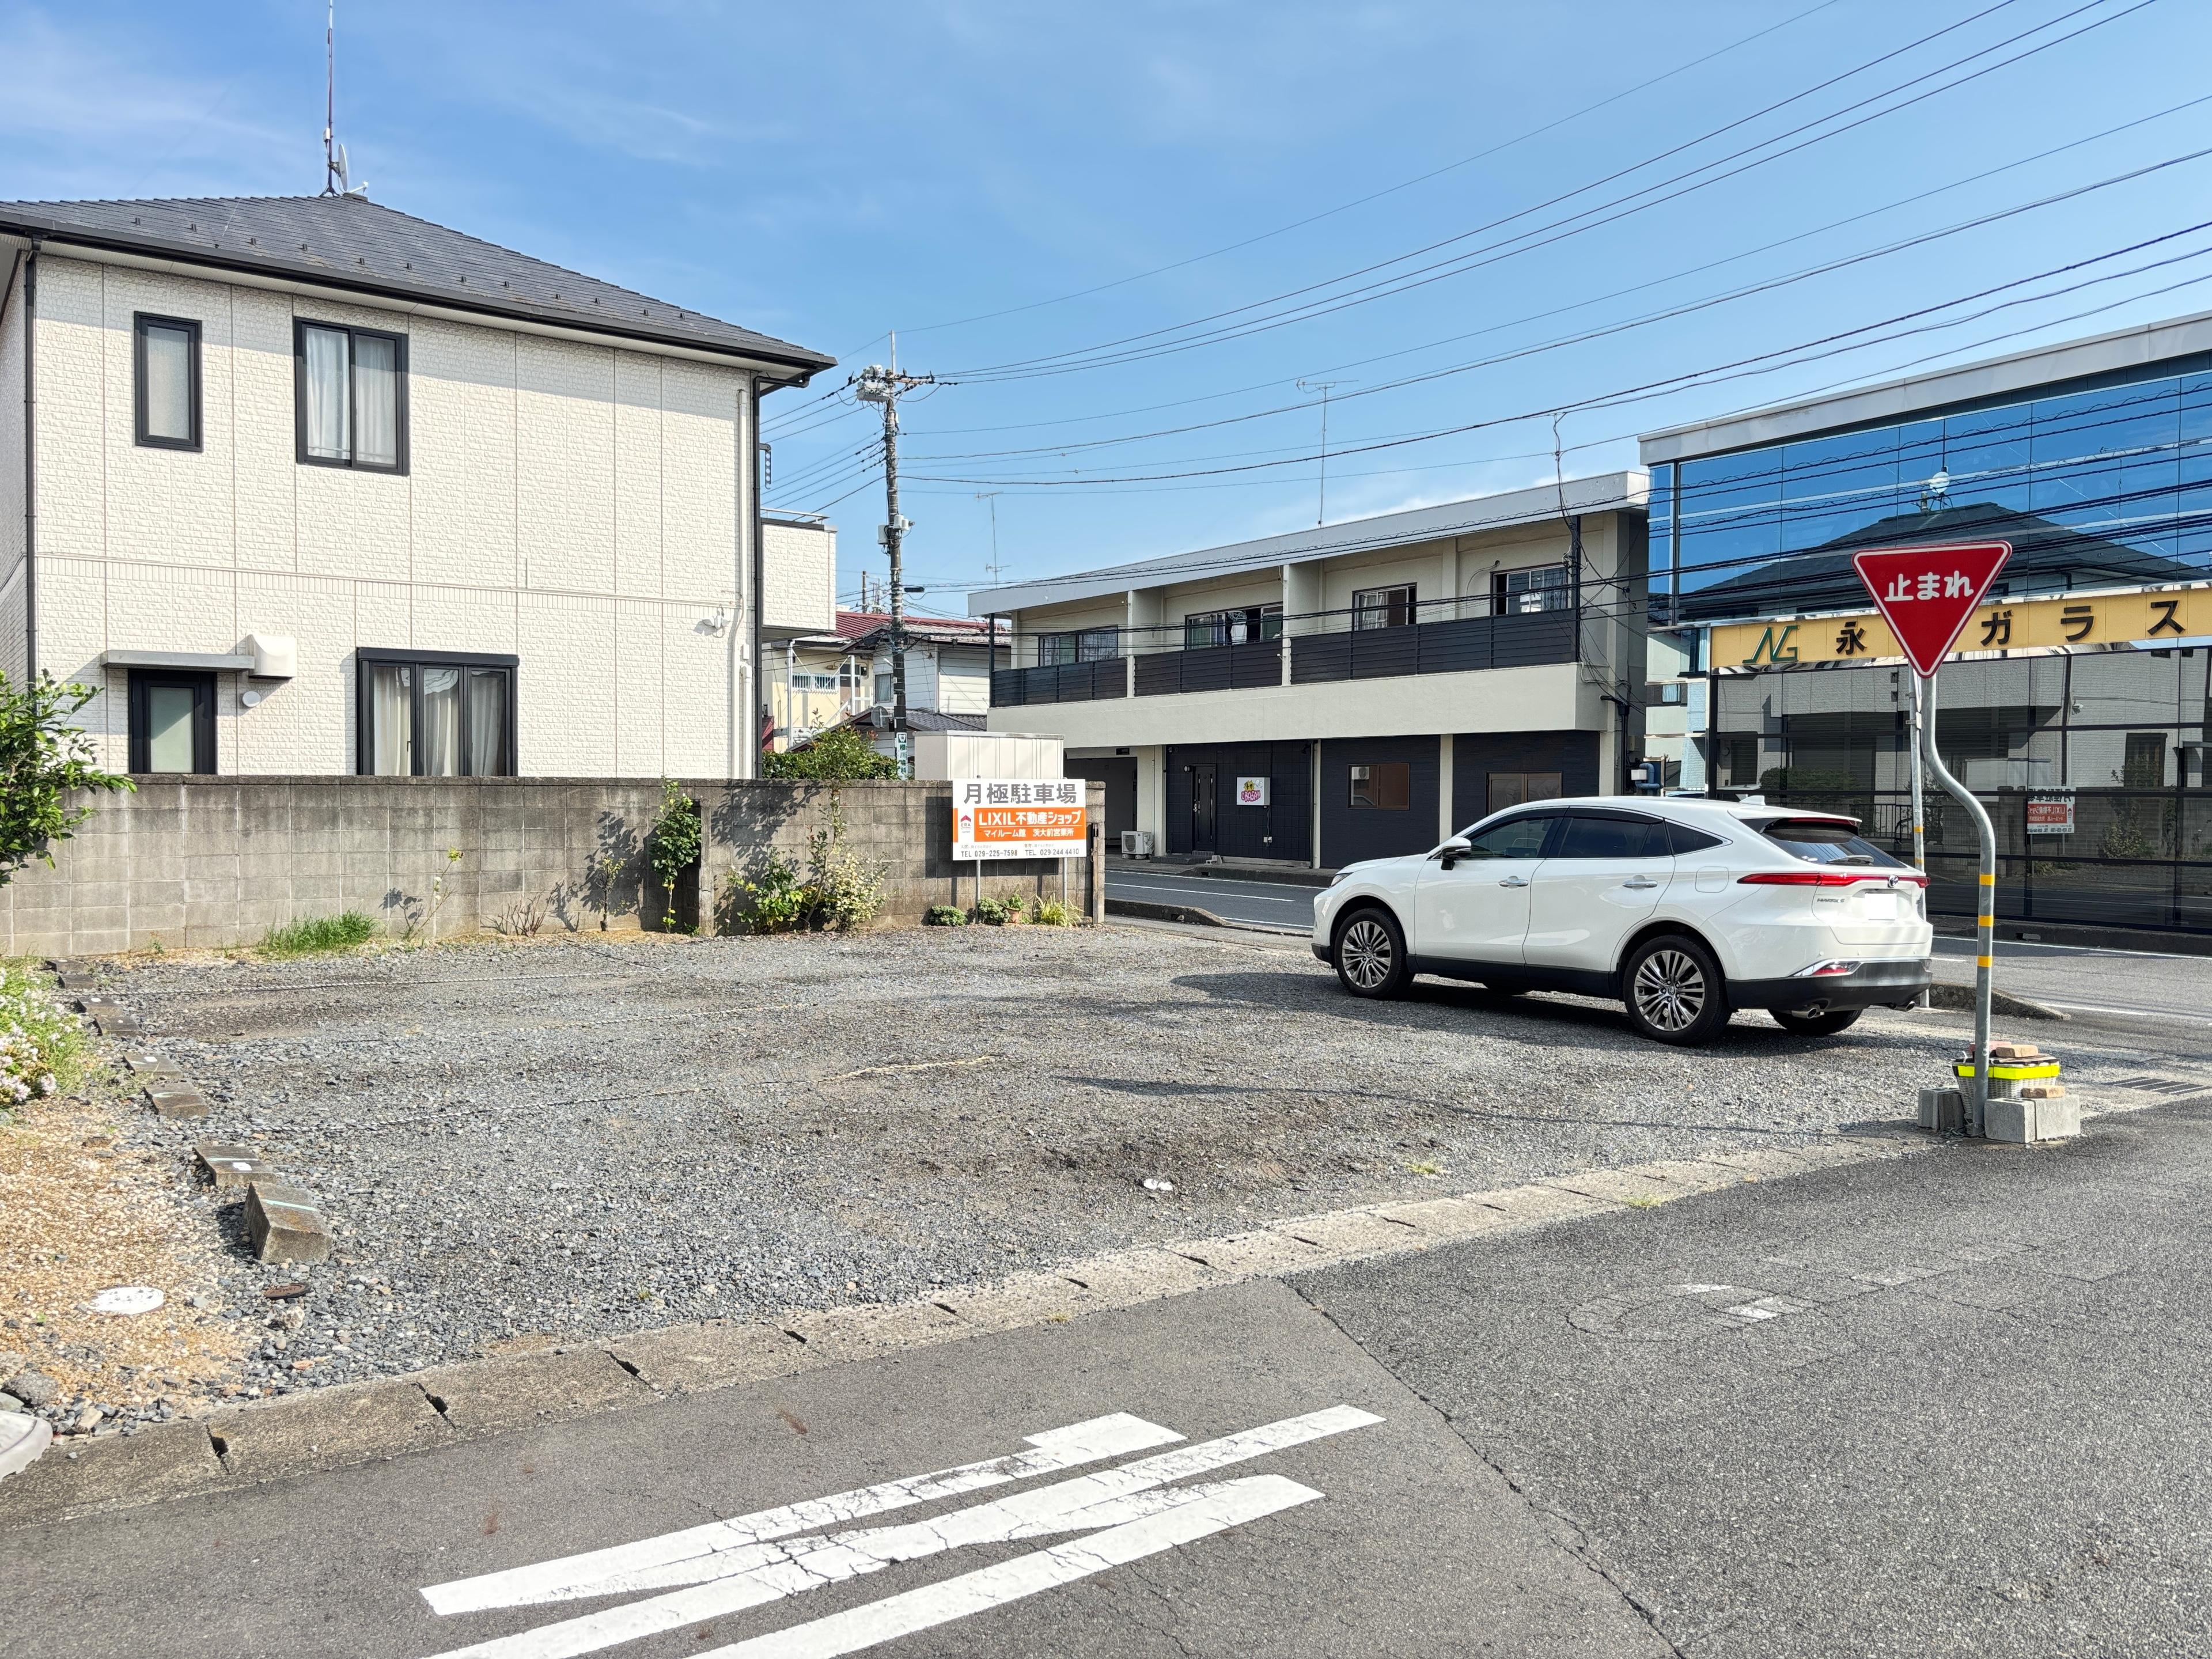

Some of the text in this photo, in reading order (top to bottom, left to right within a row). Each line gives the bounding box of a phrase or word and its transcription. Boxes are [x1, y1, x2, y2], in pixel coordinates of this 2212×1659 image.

[1884, 570, 1974, 601] 止まれ
[1836, 600, 2186, 656] 永ガラス
[964, 783, 1077, 804] 月極駐車場
[979, 810, 1082, 825] LIXIL不動産ショップ
[984, 828, 1074, 838] マイルーム館 茨大前営業所
